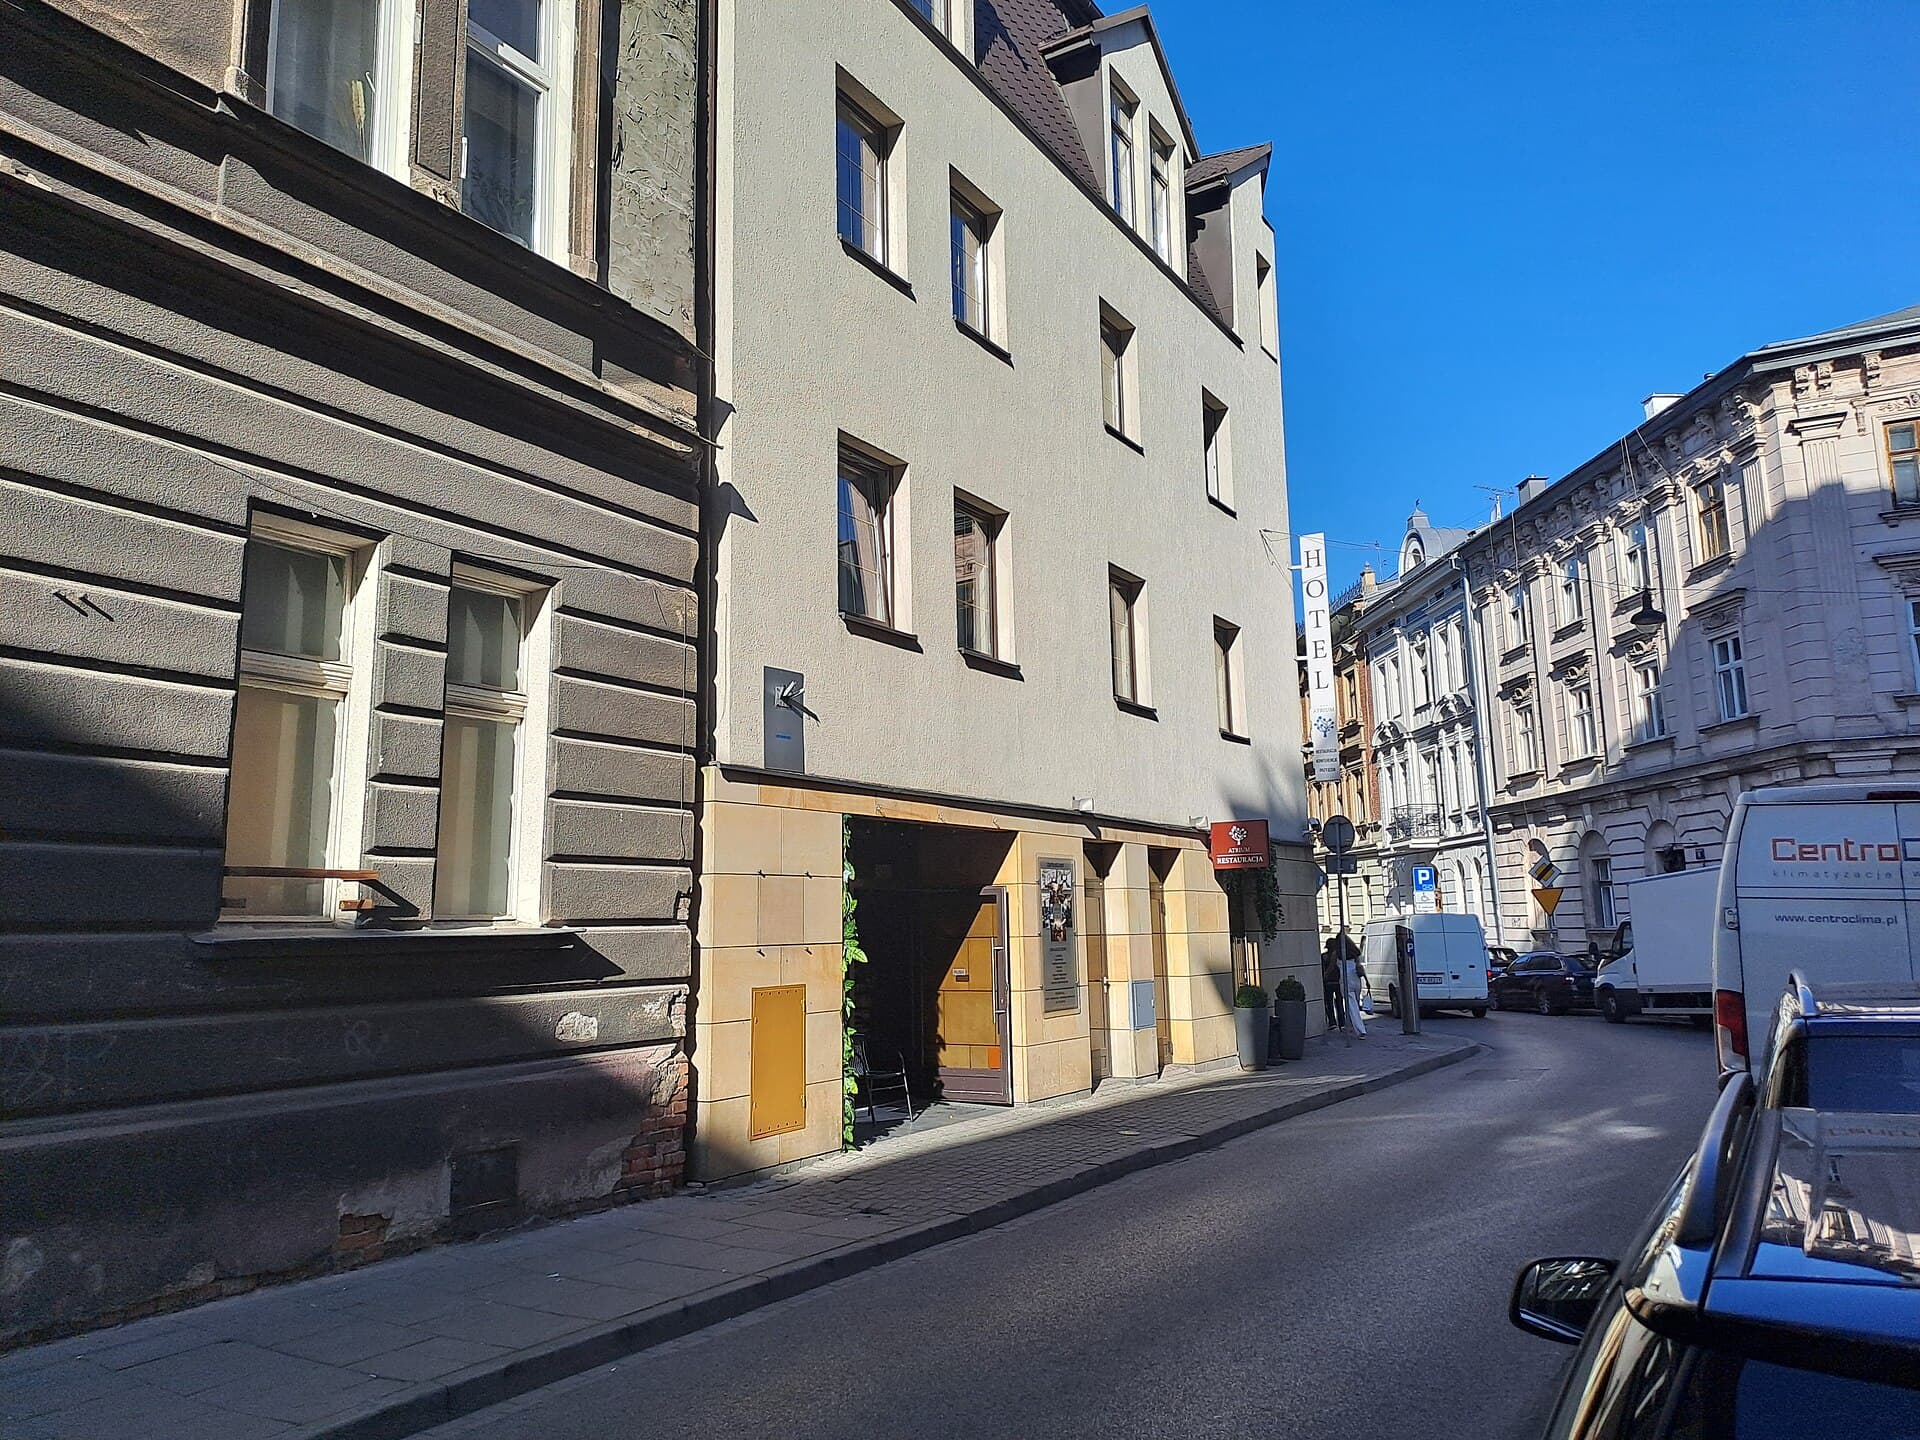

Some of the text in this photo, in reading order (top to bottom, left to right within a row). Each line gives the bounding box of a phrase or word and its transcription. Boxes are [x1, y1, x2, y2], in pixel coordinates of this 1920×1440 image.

[1305, 549, 1329, 690] HOTEL
[1216, 856, 1264, 865] RESTAURACJA
[1417, 869, 1430, 885] P
[1774, 914, 1899, 926] www.centroclima.pl
[1407, 942, 1414, 953] P
